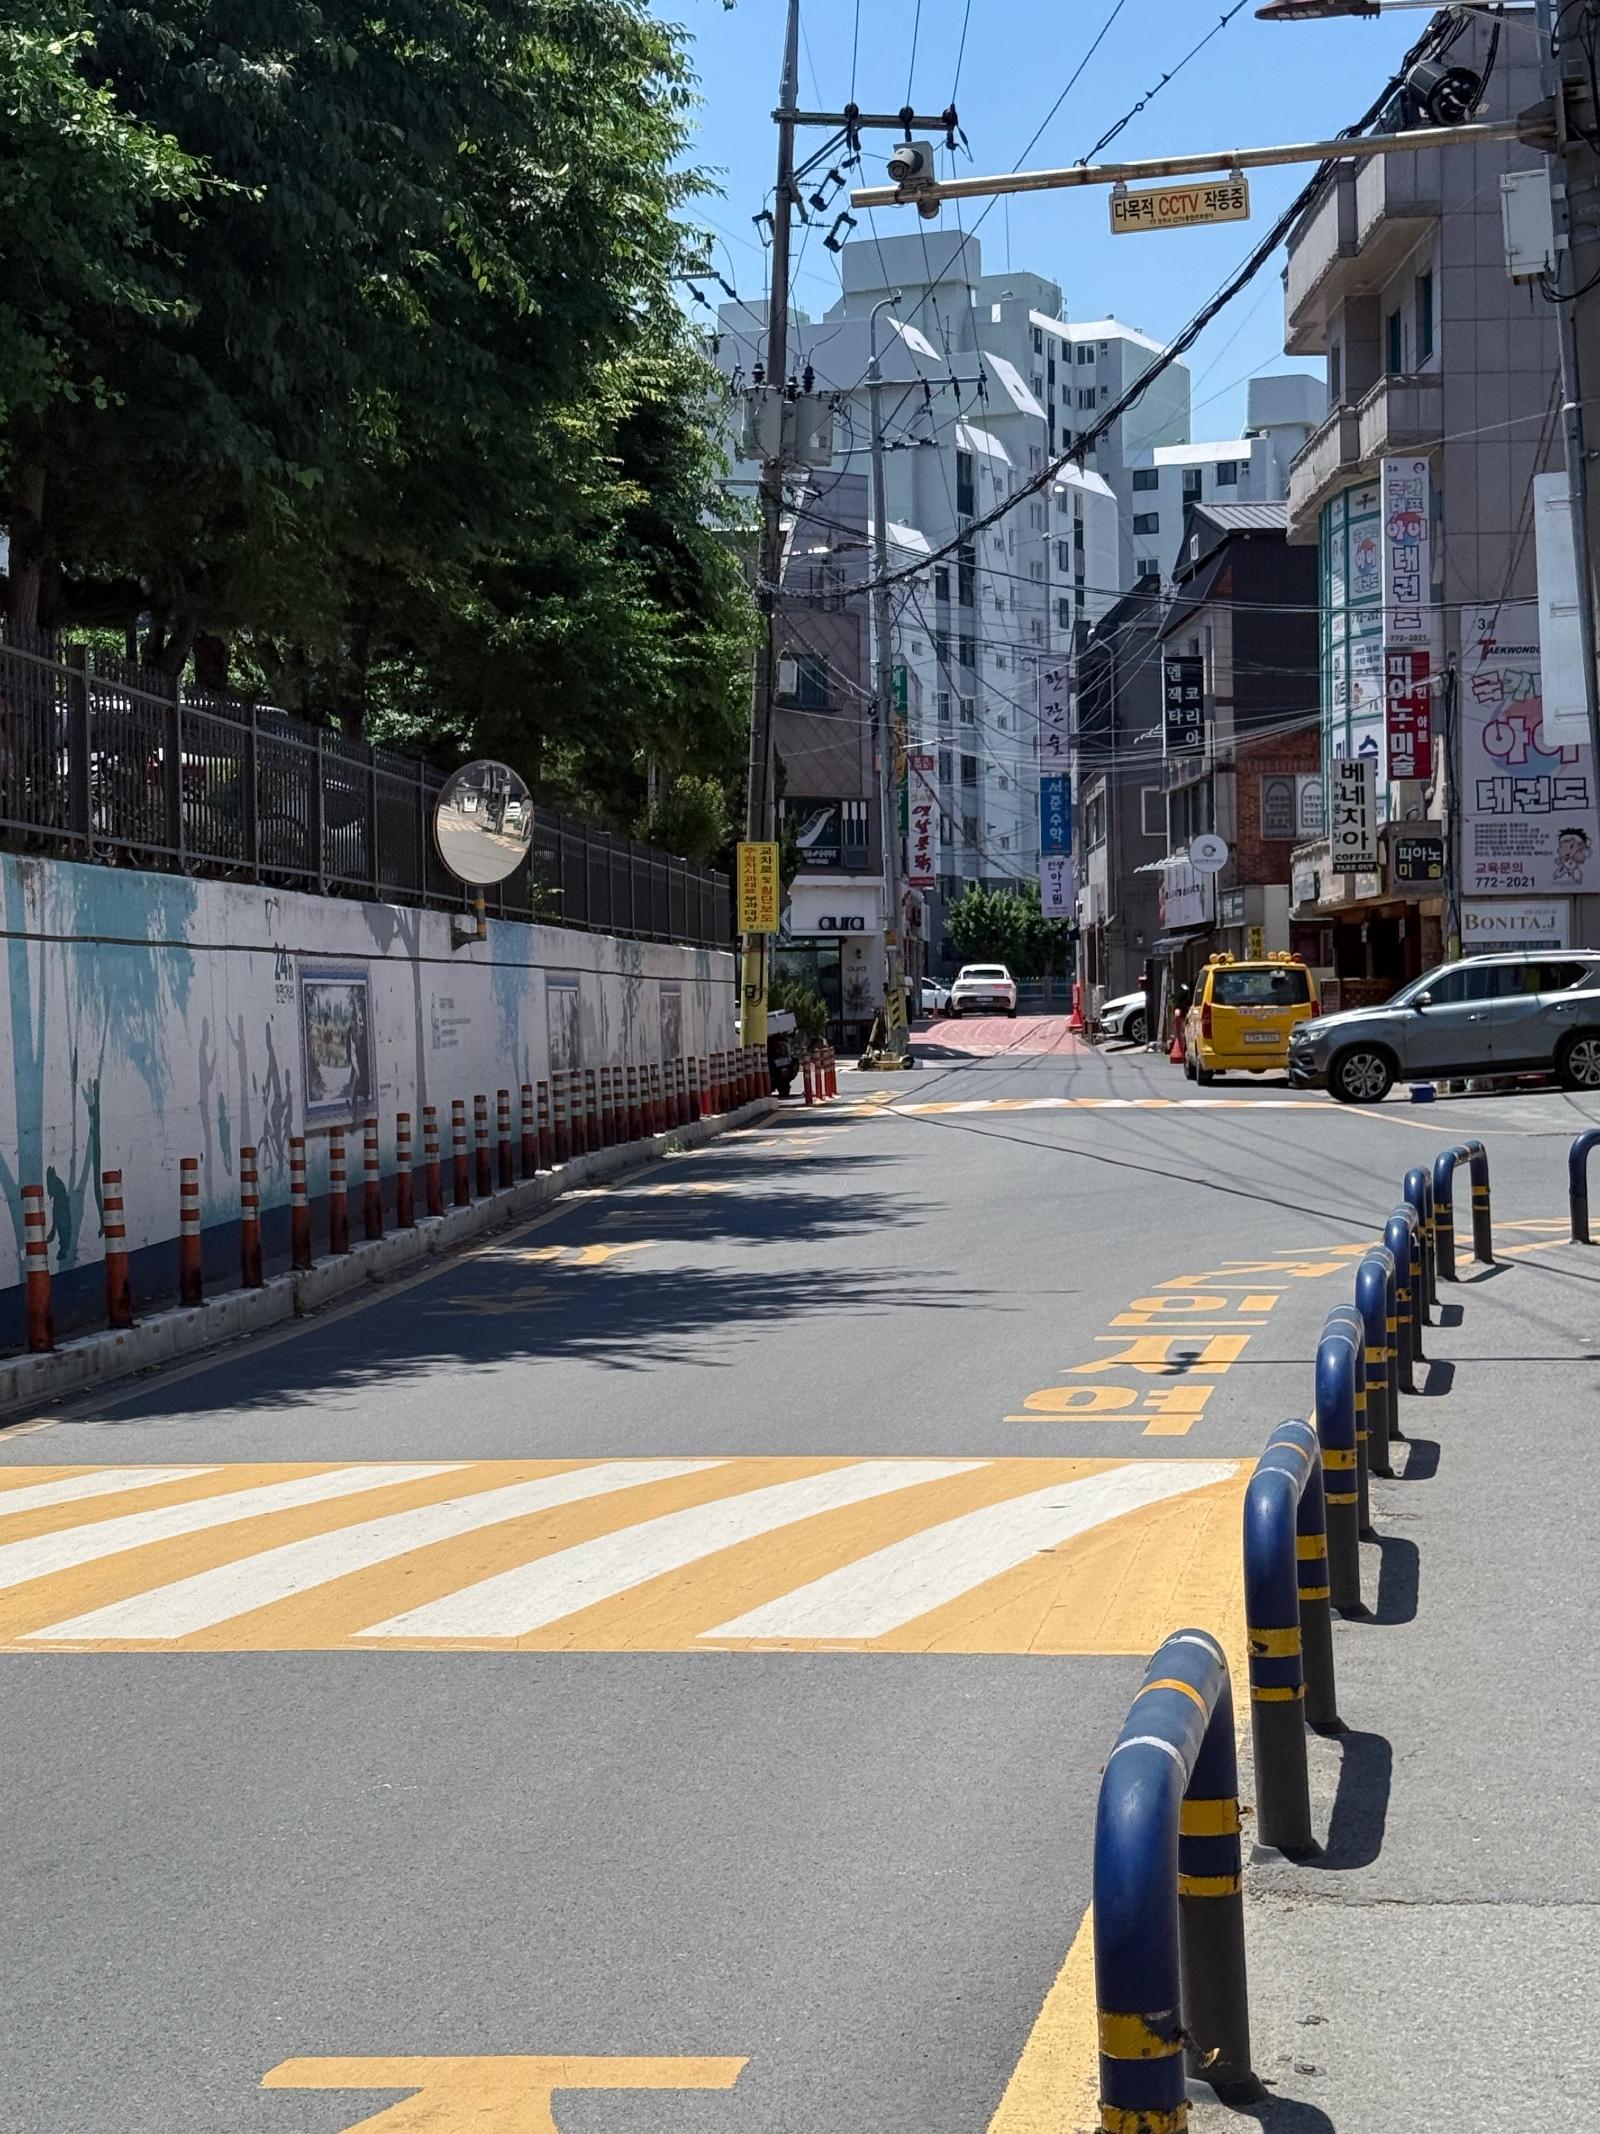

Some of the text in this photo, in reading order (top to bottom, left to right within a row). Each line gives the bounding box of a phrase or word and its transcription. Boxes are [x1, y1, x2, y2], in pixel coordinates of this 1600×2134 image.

[1115, 187, 1243, 221] 다목적 CCTV 작동중
[1386, 512, 1427, 541] 아이
[1392, 545, 1421, 629] 태권도
[1341, 763, 1369, 850] 베네치아
[1476, 776, 1589, 814] 태권도
[760, 846, 773, 873] 교차로
[1335, 853, 1374, 861] COFFEE
[1336, 863, 1356, 872] TAKE
[1399, 846, 1442, 862] 피아노
[1475, 861, 1524, 874] 교육문의
[1475, 876, 1536, 888] 772-2021
[819, 916, 865, 931] aura
[1002, 1261, 1351, 1436] 견인지역
